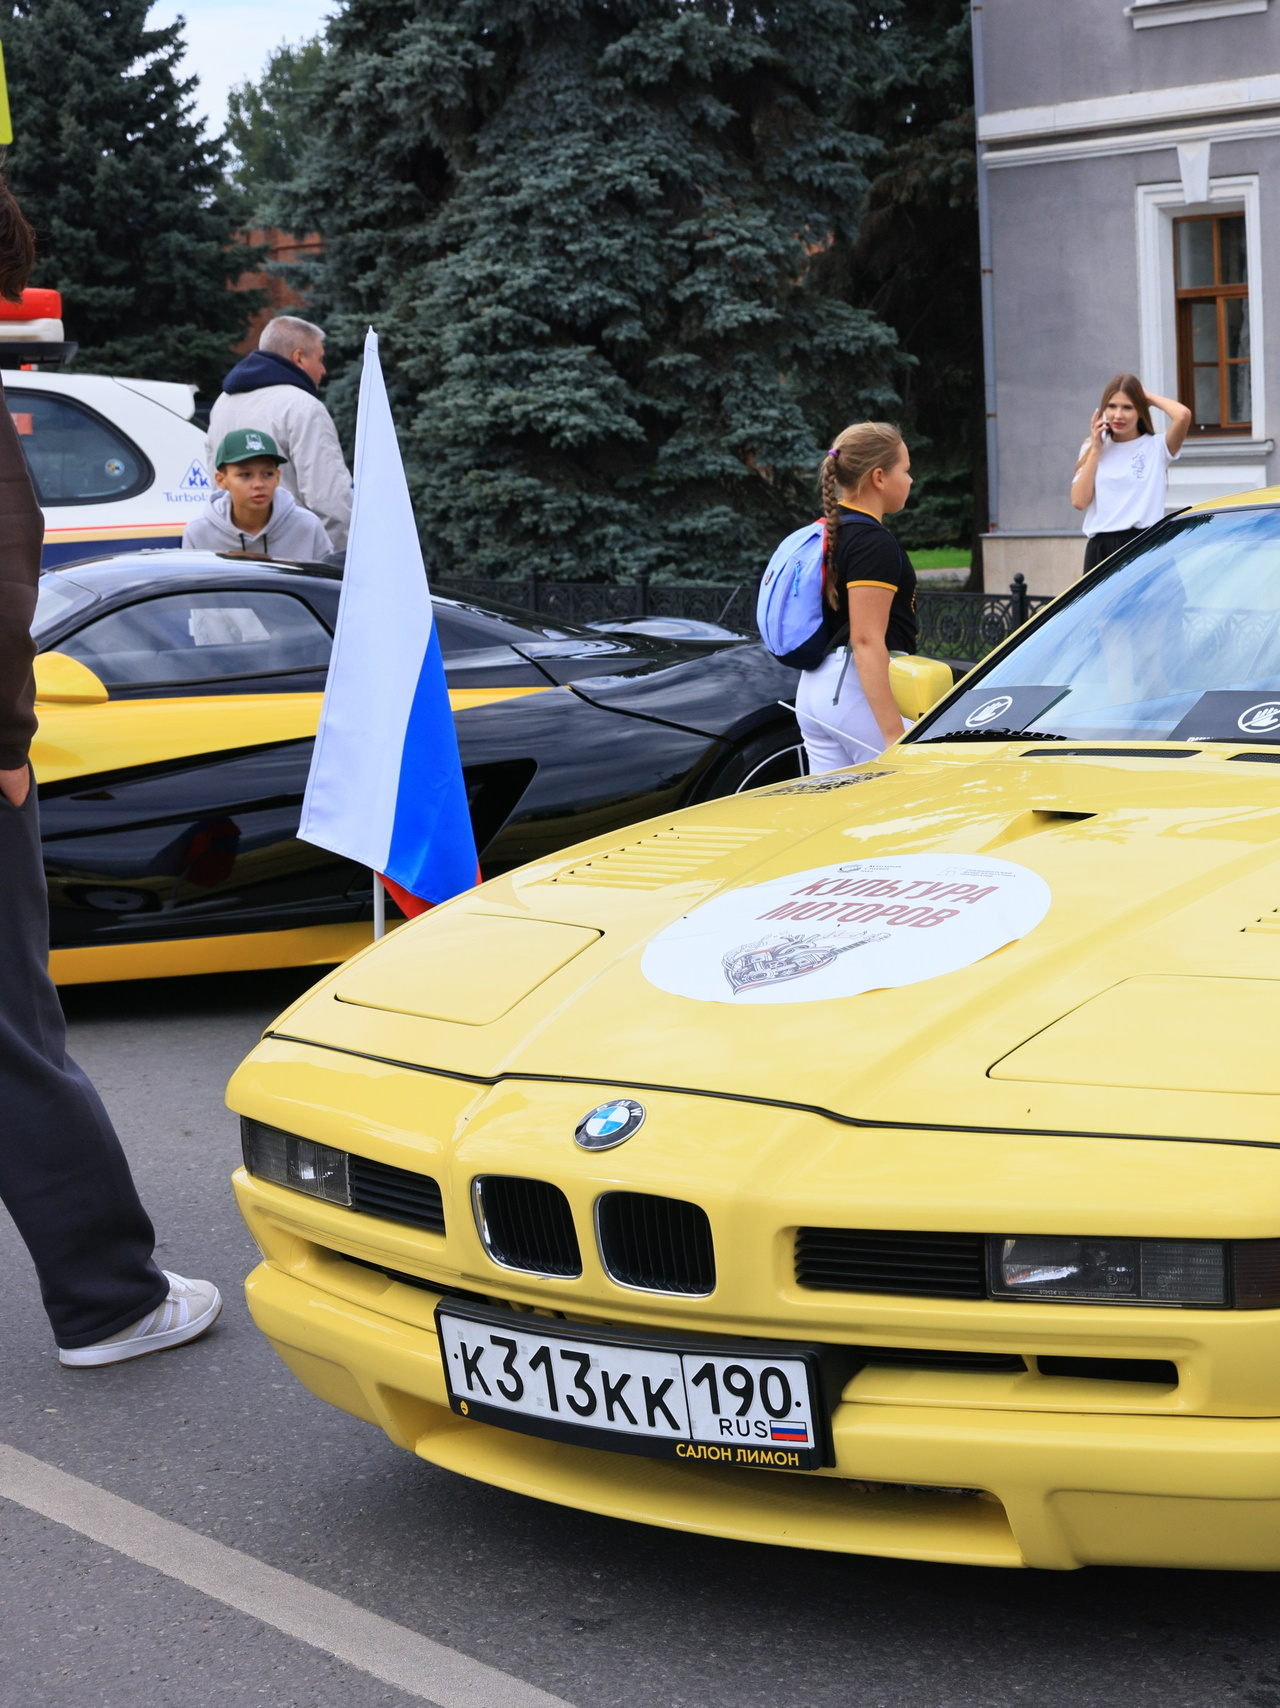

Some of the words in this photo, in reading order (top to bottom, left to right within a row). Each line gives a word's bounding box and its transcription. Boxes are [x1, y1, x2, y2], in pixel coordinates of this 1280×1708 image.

[790, 878, 1000, 904] КУЛЬТУРА
[754, 901, 961, 928] МОТОРОВ
[691, 1362, 792, 1420] 190
[719, 1418, 768, 1439] RUS
[676, 1443, 732, 1462] САЛОН
[736, 1448, 799, 1467] ЛИМОН
